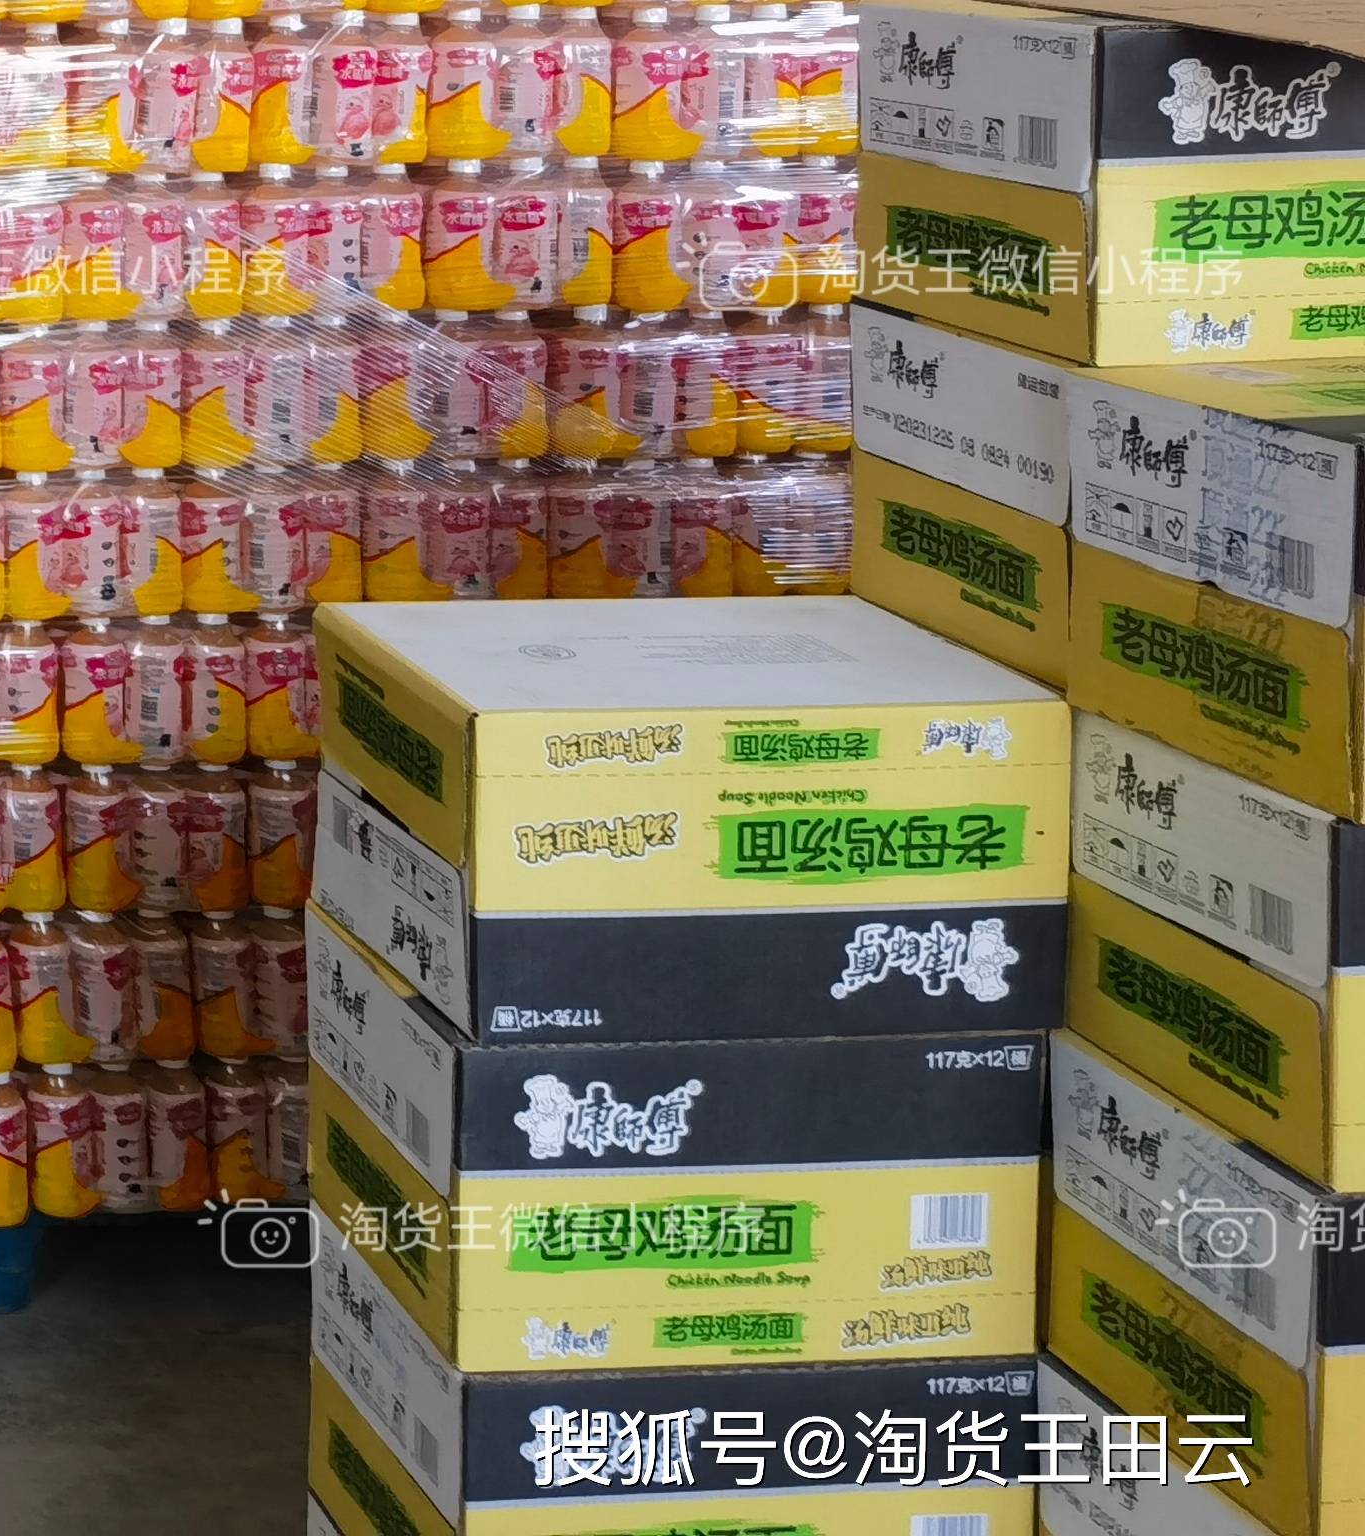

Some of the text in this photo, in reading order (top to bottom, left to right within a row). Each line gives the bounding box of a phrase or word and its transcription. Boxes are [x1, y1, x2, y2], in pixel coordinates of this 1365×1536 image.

[1169, 189, 1365, 251] 老母鸡汤
[888, 504, 1027, 603] 老母鸡汤面
[1111, 606, 1289, 719] 老母鸡汤面
[733, 729, 871, 761] 老母鸡汤面
[734, 812, 1007, 875] 老母鸡汤面
[533, 1202, 795, 1262] 老母鸡汤面
[662, 1313, 795, 1343] 老母鸡汤面
